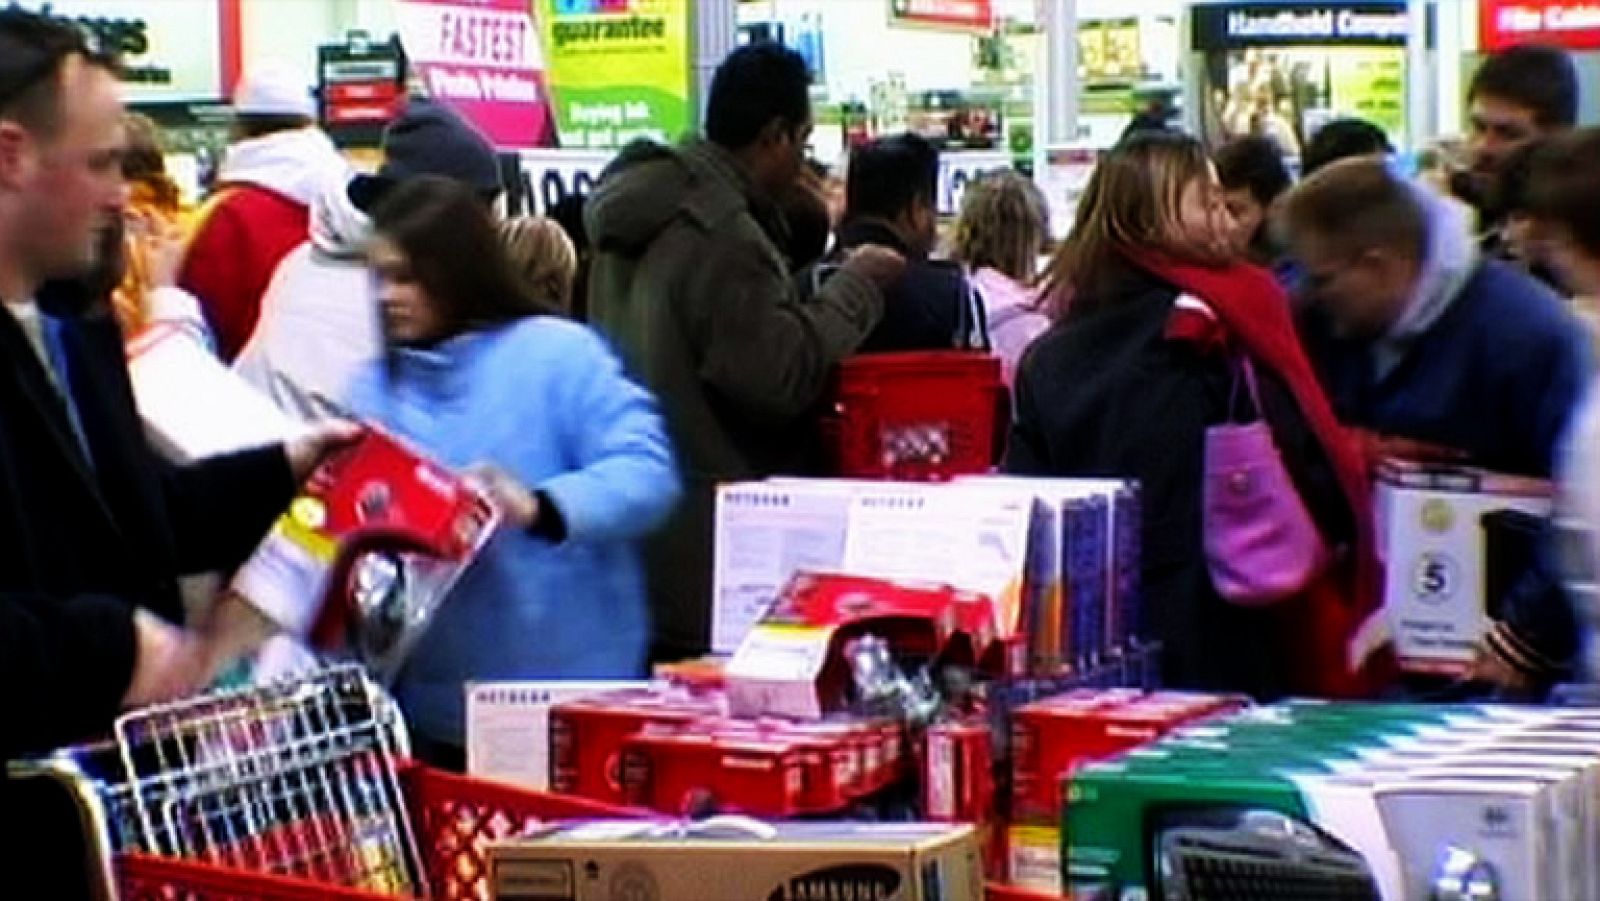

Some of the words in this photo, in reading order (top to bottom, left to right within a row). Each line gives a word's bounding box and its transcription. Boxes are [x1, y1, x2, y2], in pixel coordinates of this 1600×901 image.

[439, 11, 527, 62] FASTEST
[551, 15, 665, 47] guarantee
[1228, 8, 1334, 37] Handheld
[1422, 561, 1447, 593] 5
